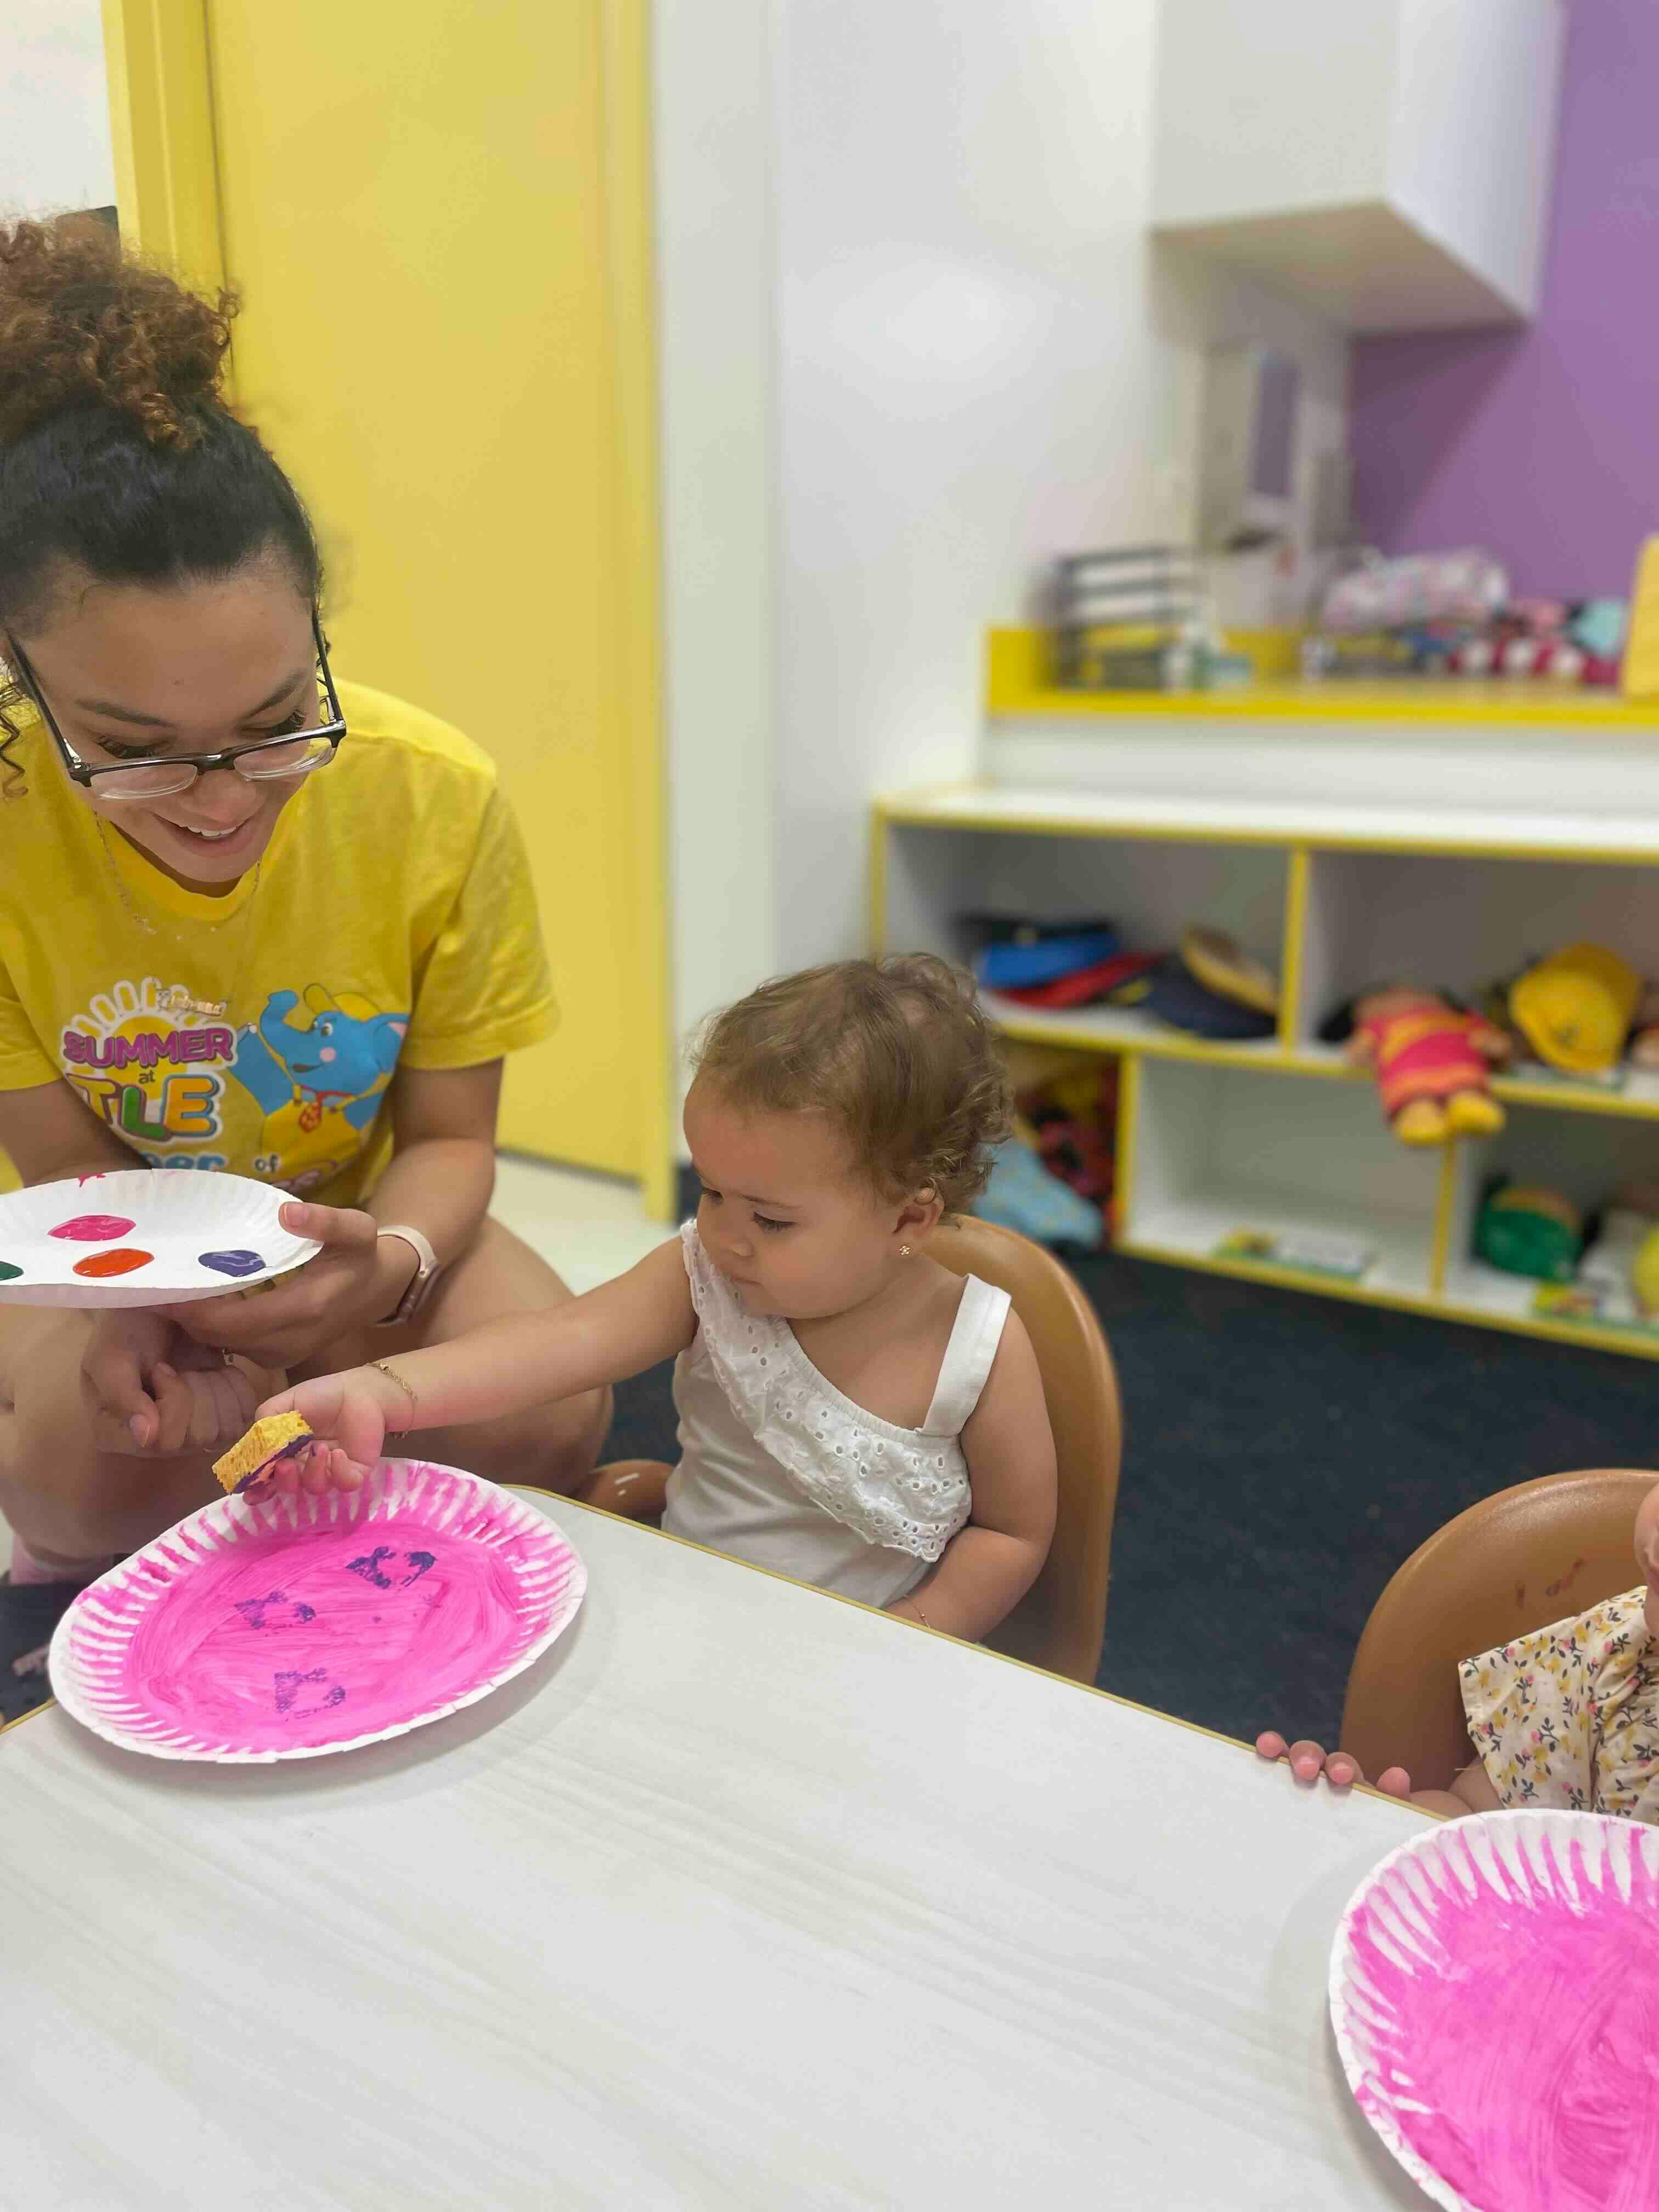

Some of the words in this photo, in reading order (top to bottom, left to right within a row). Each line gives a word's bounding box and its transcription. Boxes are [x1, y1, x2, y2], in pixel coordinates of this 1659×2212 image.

[63, 1028, 233, 1070] SUMMER
[138, 1070, 155, 1084] at
[254, 1154, 279, 1172] of
